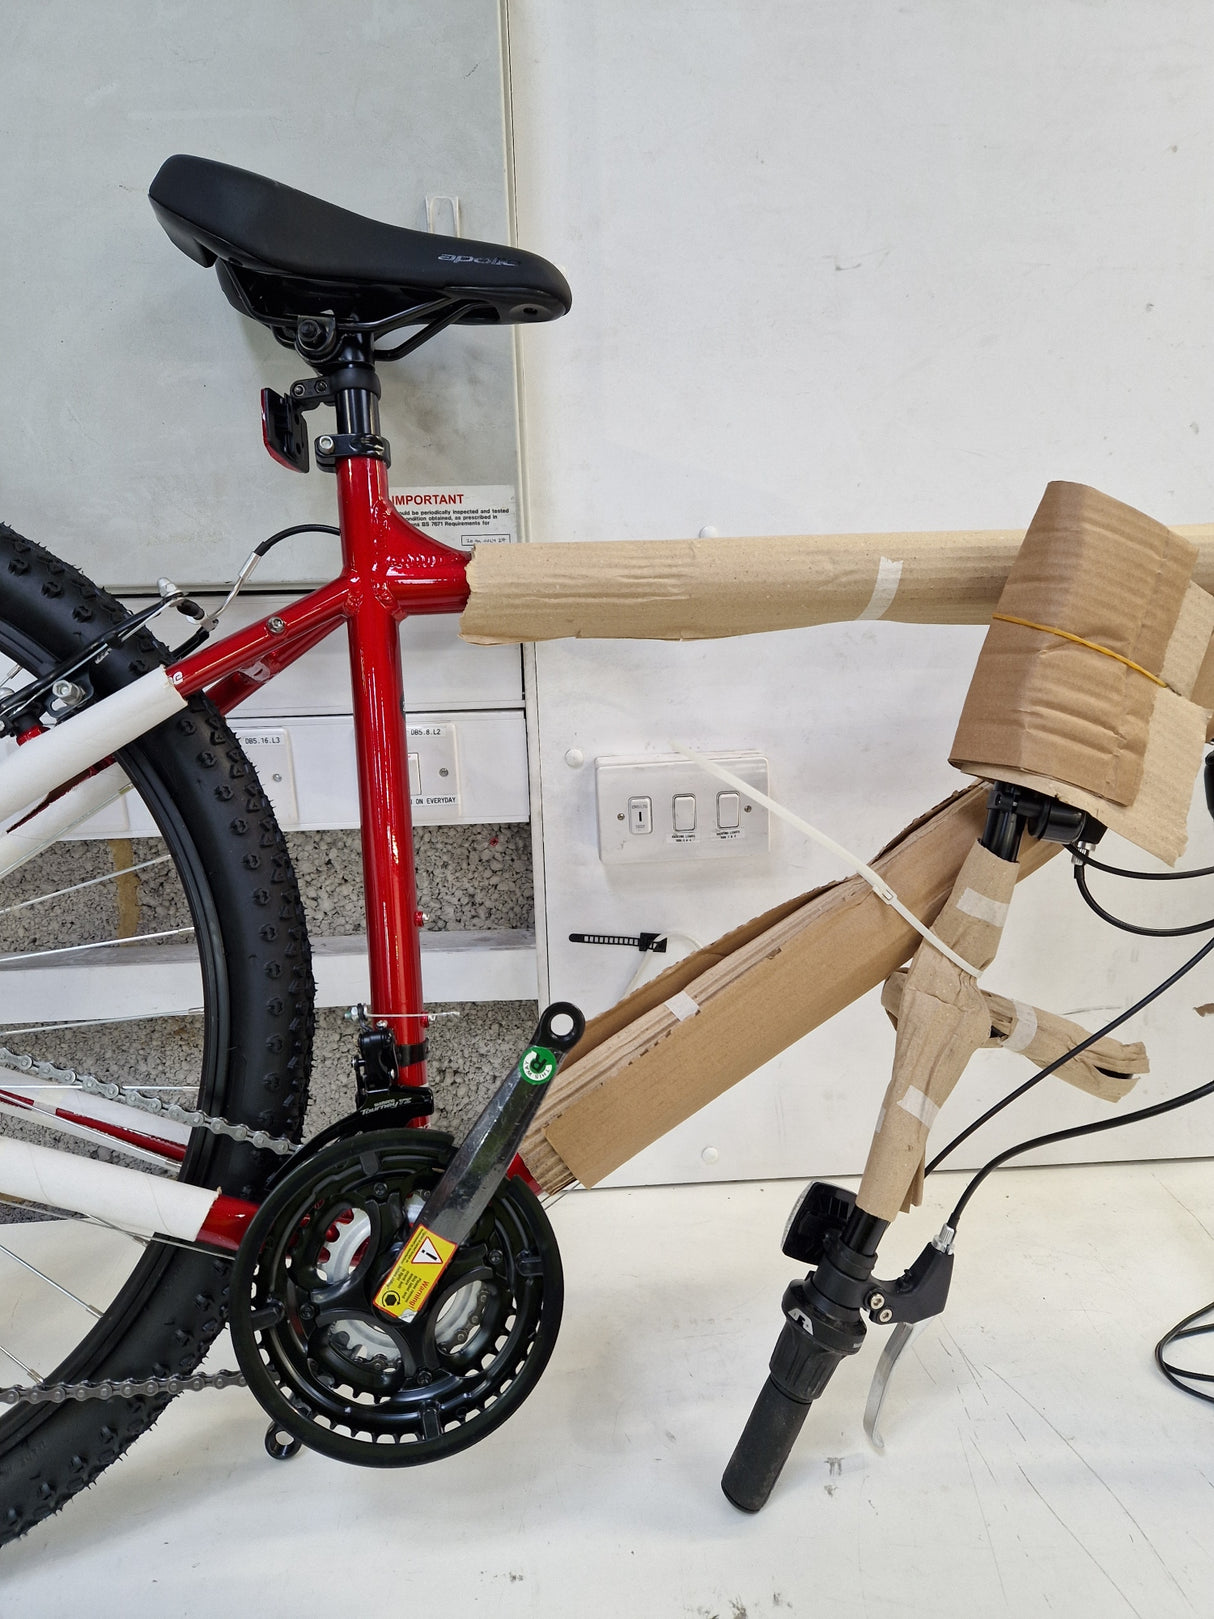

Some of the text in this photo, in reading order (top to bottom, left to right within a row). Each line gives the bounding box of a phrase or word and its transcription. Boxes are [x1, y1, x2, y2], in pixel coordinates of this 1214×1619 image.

[391, 494, 464, 506] IMPORTANT
[420, 509, 451, 517] periodically
[426, 797, 456, 805] EVERYDAY
[360, 1100, 399, 1115] Tourney
[409, 1280, 429, 1309] Warning!
